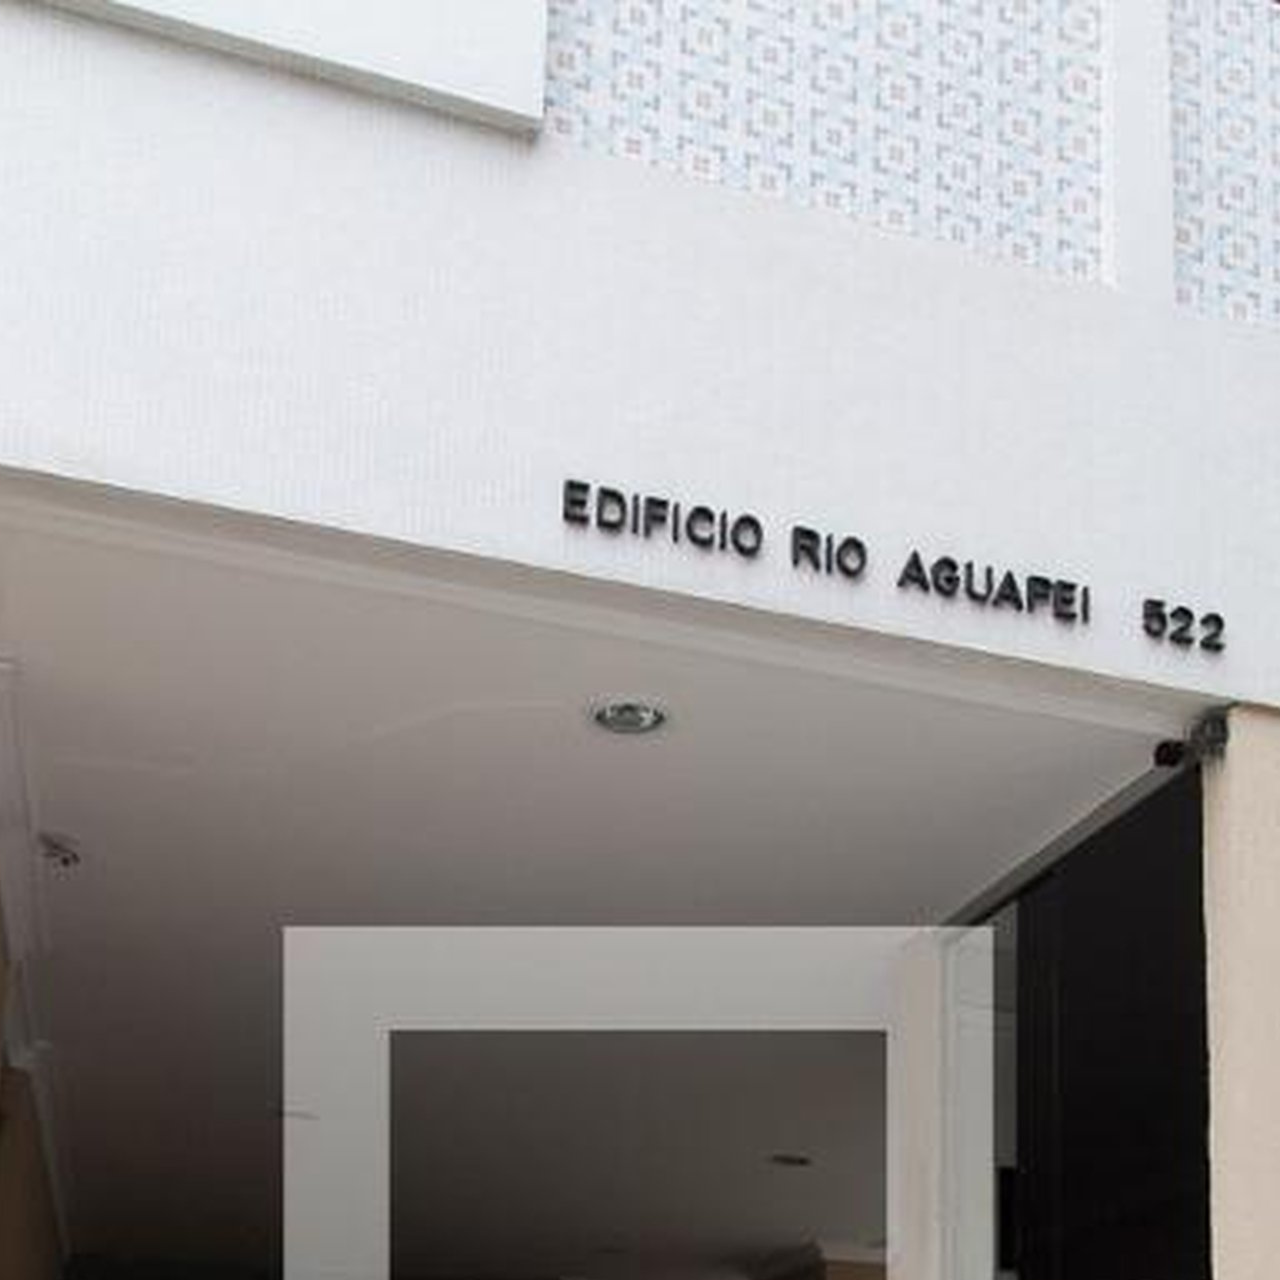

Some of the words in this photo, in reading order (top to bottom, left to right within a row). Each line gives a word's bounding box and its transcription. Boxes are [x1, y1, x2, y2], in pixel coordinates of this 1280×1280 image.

[563, 479, 763, 558] EDIFICIO
[792, 525, 867, 578] RIO
[1143, 599, 1224, 652] 522
